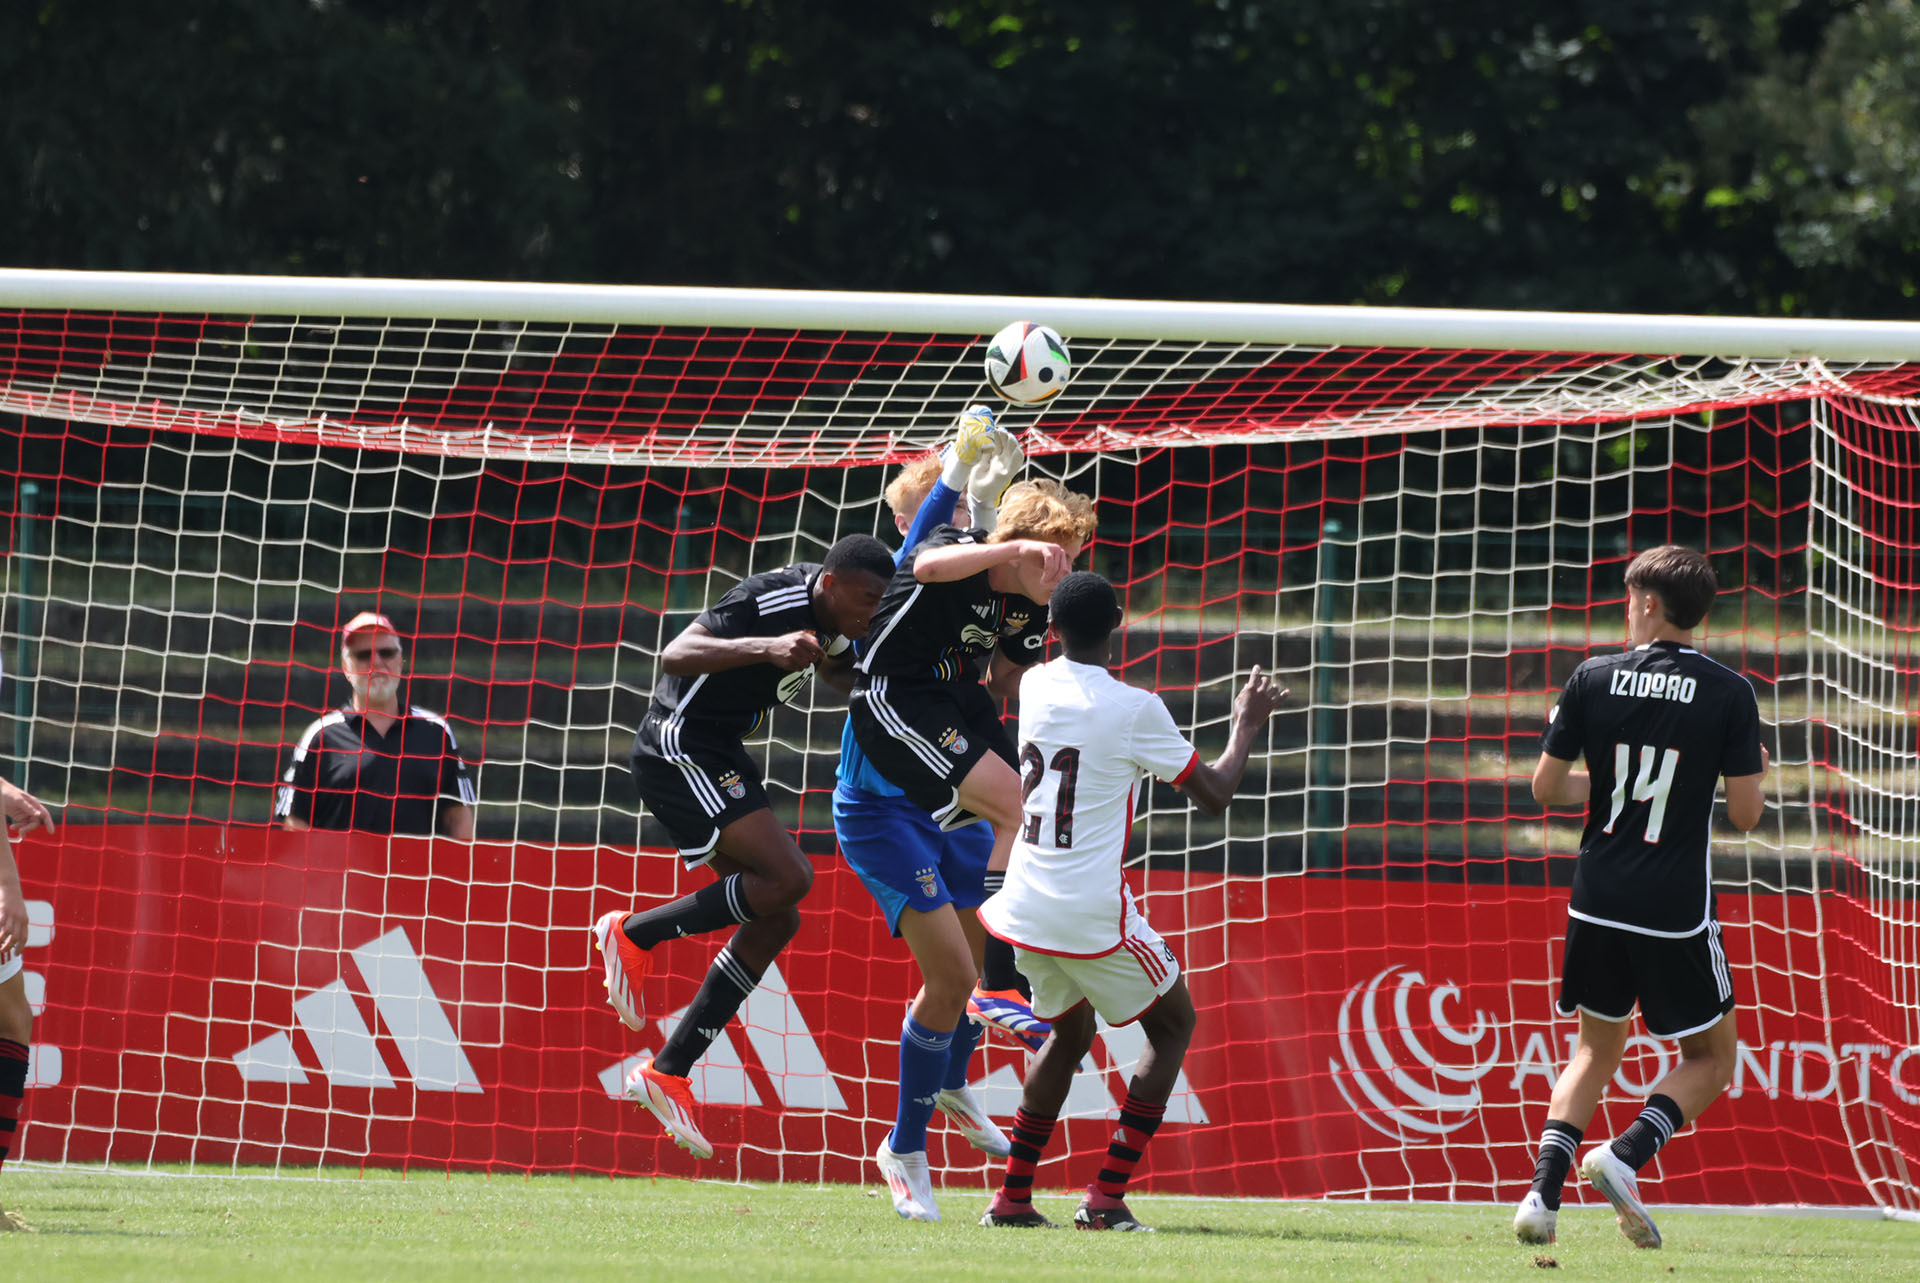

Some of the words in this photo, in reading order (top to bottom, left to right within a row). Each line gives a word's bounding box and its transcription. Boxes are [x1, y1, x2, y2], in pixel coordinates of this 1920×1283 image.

[1609, 669, 1697, 704] IZIDORO
[1020, 742, 1081, 849] 21
[1602, 743, 1680, 844] 14
